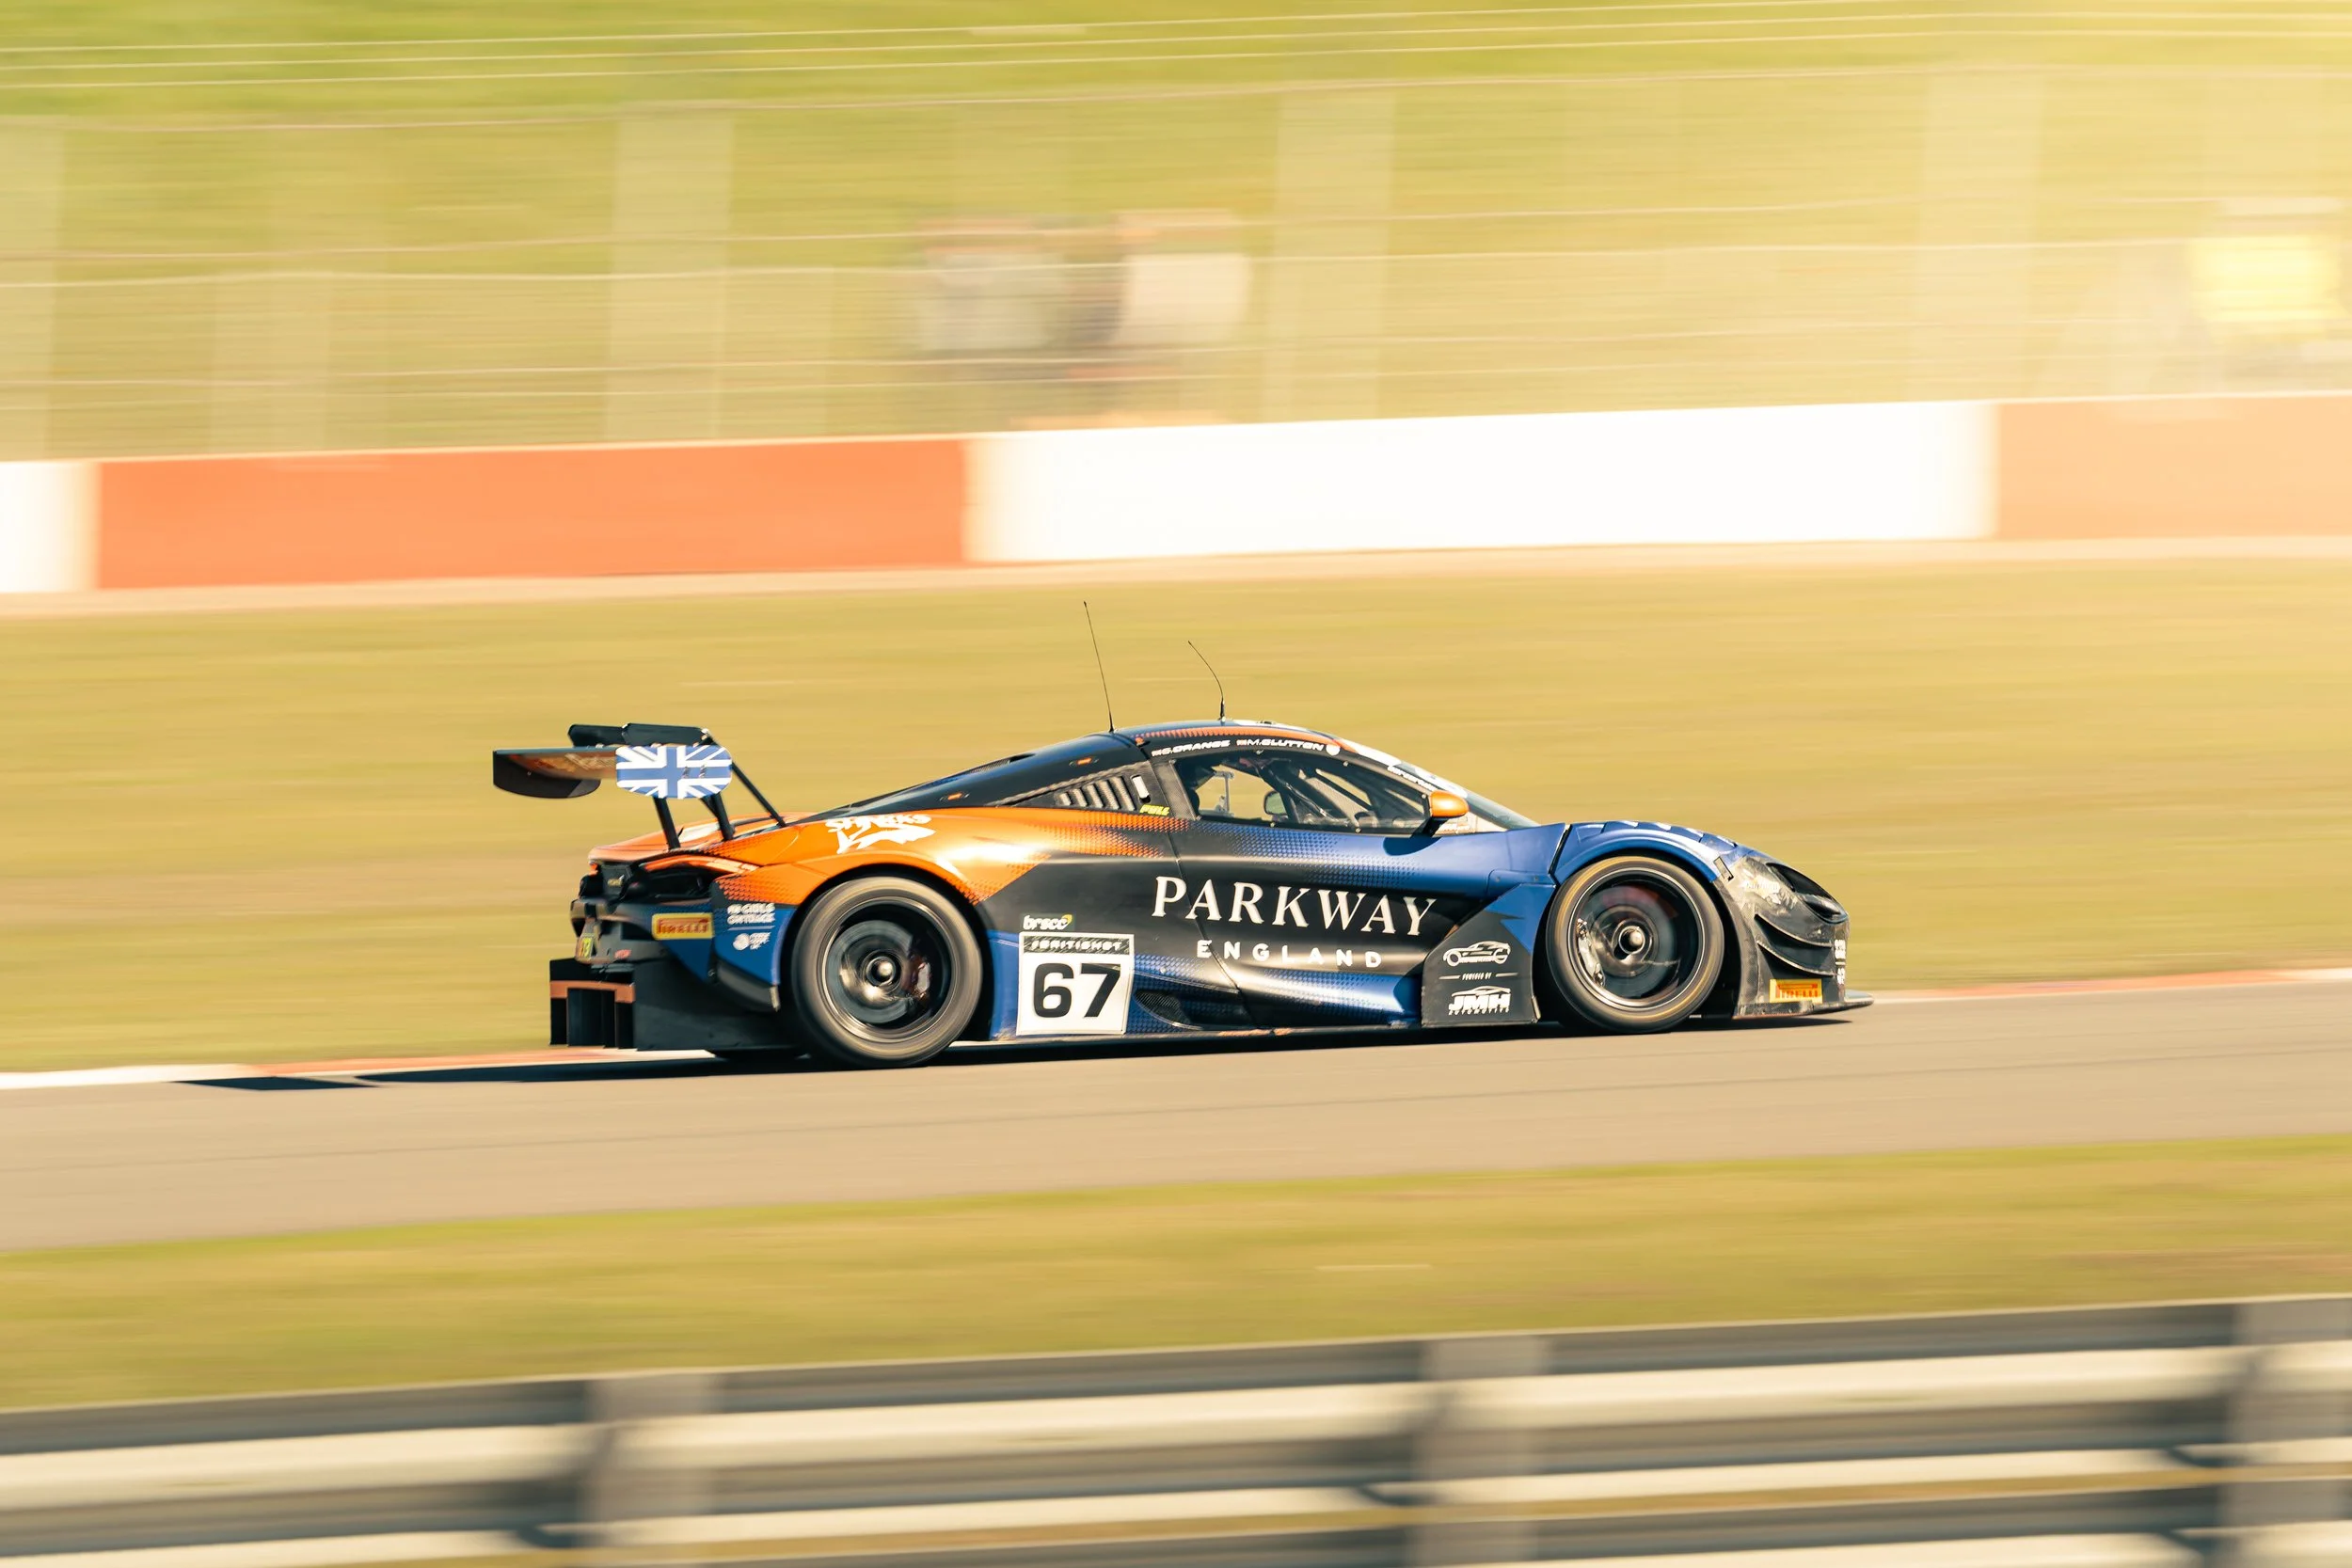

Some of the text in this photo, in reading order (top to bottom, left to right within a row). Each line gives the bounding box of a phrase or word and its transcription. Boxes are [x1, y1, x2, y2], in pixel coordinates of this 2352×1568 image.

[1139, 804, 1170, 816] PULL
[1152, 876, 1437, 936] PARKWAY
[1197, 940, 1381, 968] ENGLAND
[1034, 962, 1120, 1018] 67
